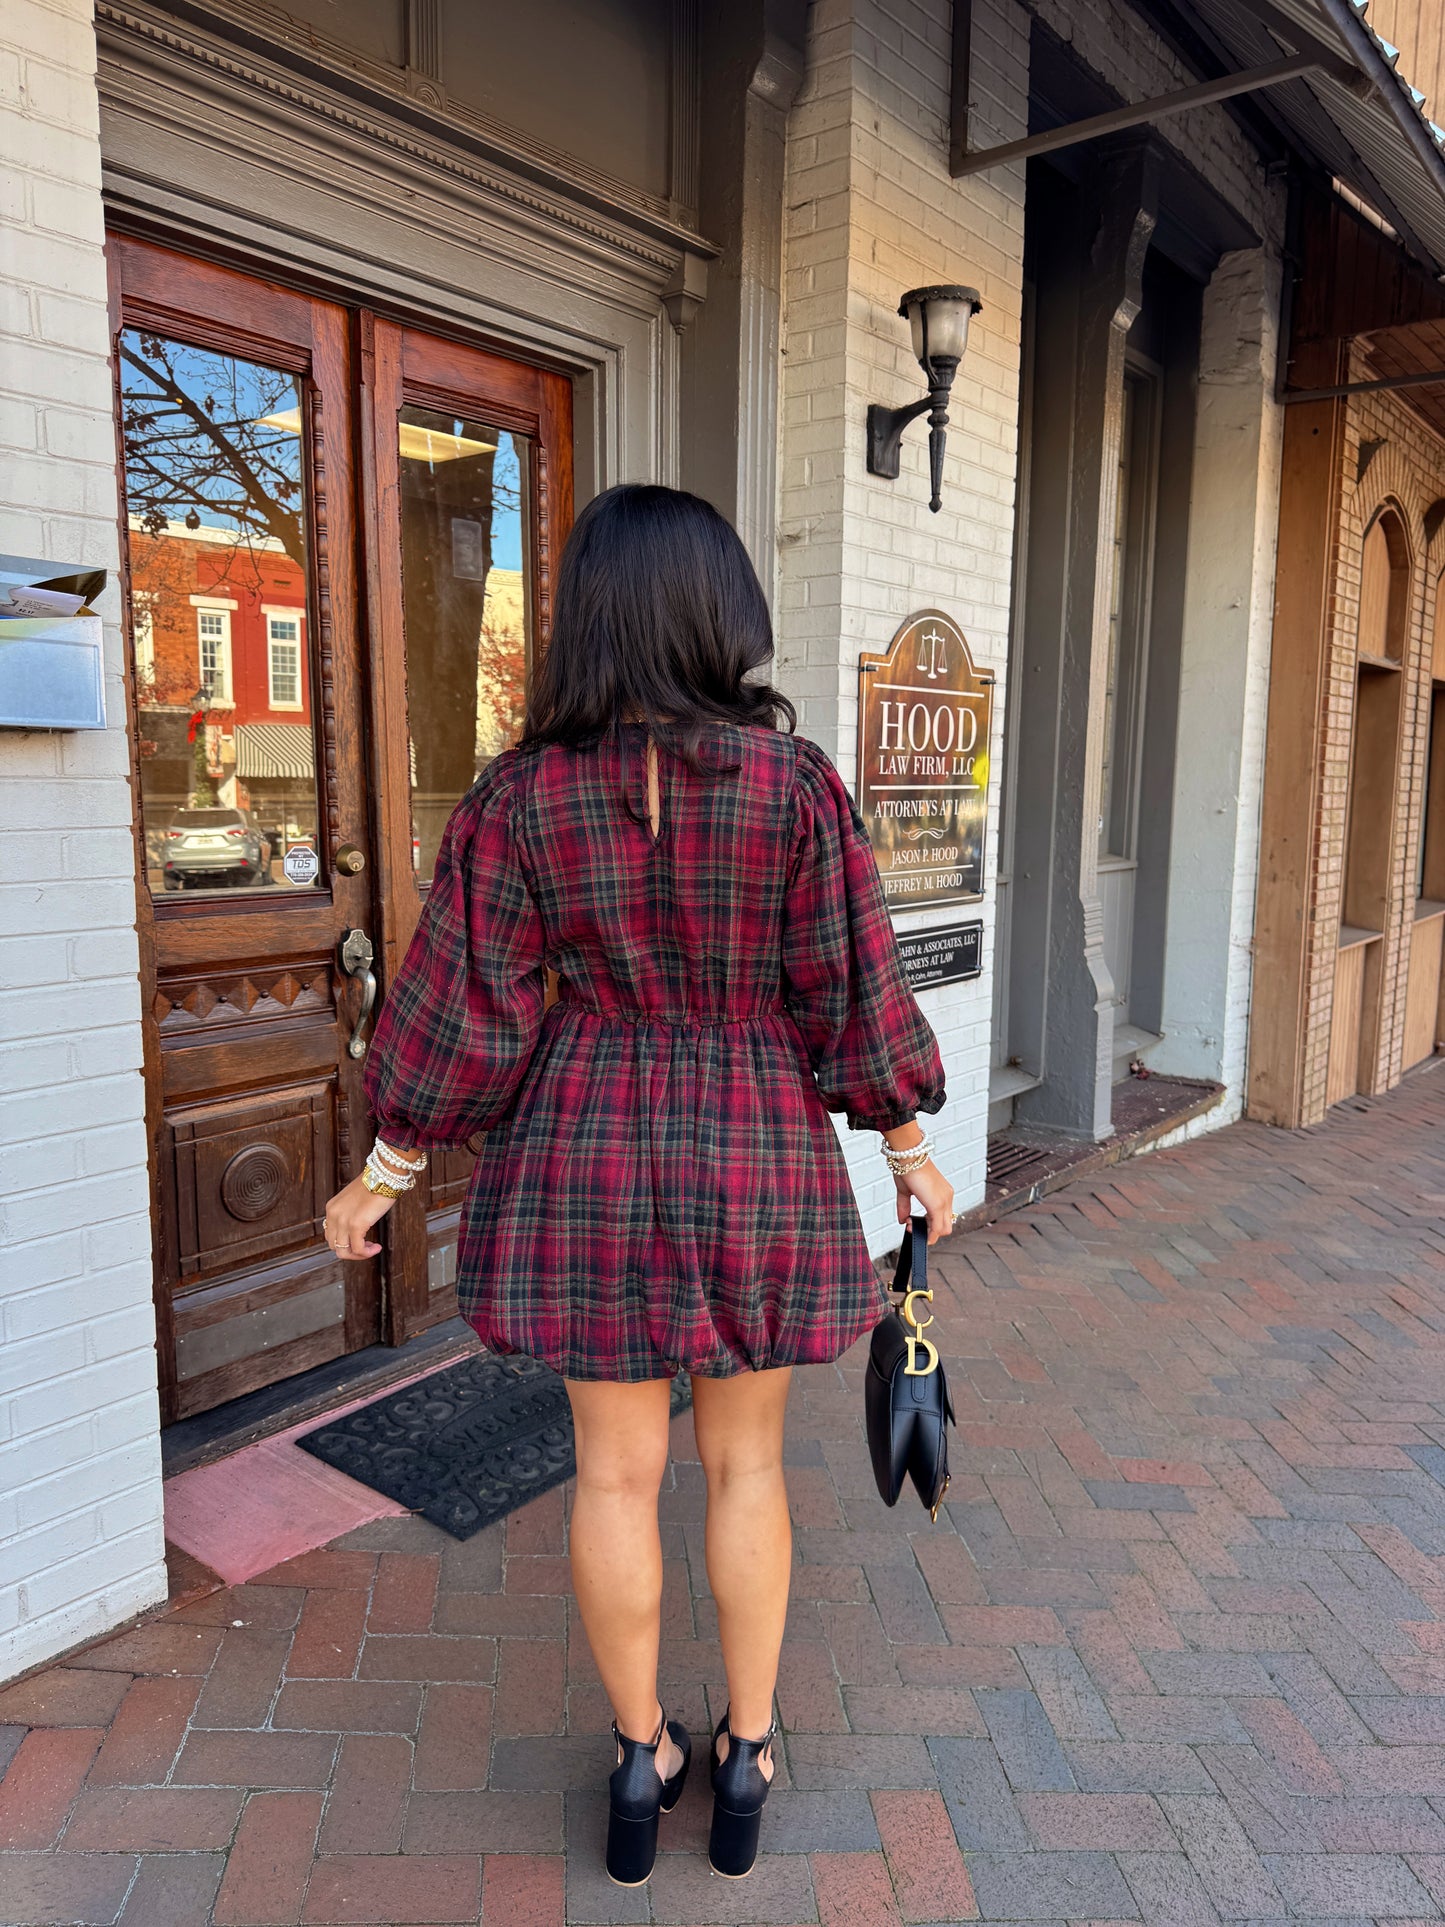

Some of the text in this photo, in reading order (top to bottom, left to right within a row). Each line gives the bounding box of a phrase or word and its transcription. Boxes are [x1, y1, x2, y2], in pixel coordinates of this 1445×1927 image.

[878, 701, 977, 753] HOOD
[878, 755, 975, 778] LAW FIRM, LLC
[874, 799, 938, 819] ATTORNEYS
[939, 799, 953, 816] AT
[889, 846, 959, 869] JASON P. HOOD
[884, 873, 963, 899] JEFFREY M. HOOD
[900, 934, 976, 957] AHN & ASSOCIATES, LLC
[903, 952, 955, 971] ORNEYS AT LAW
